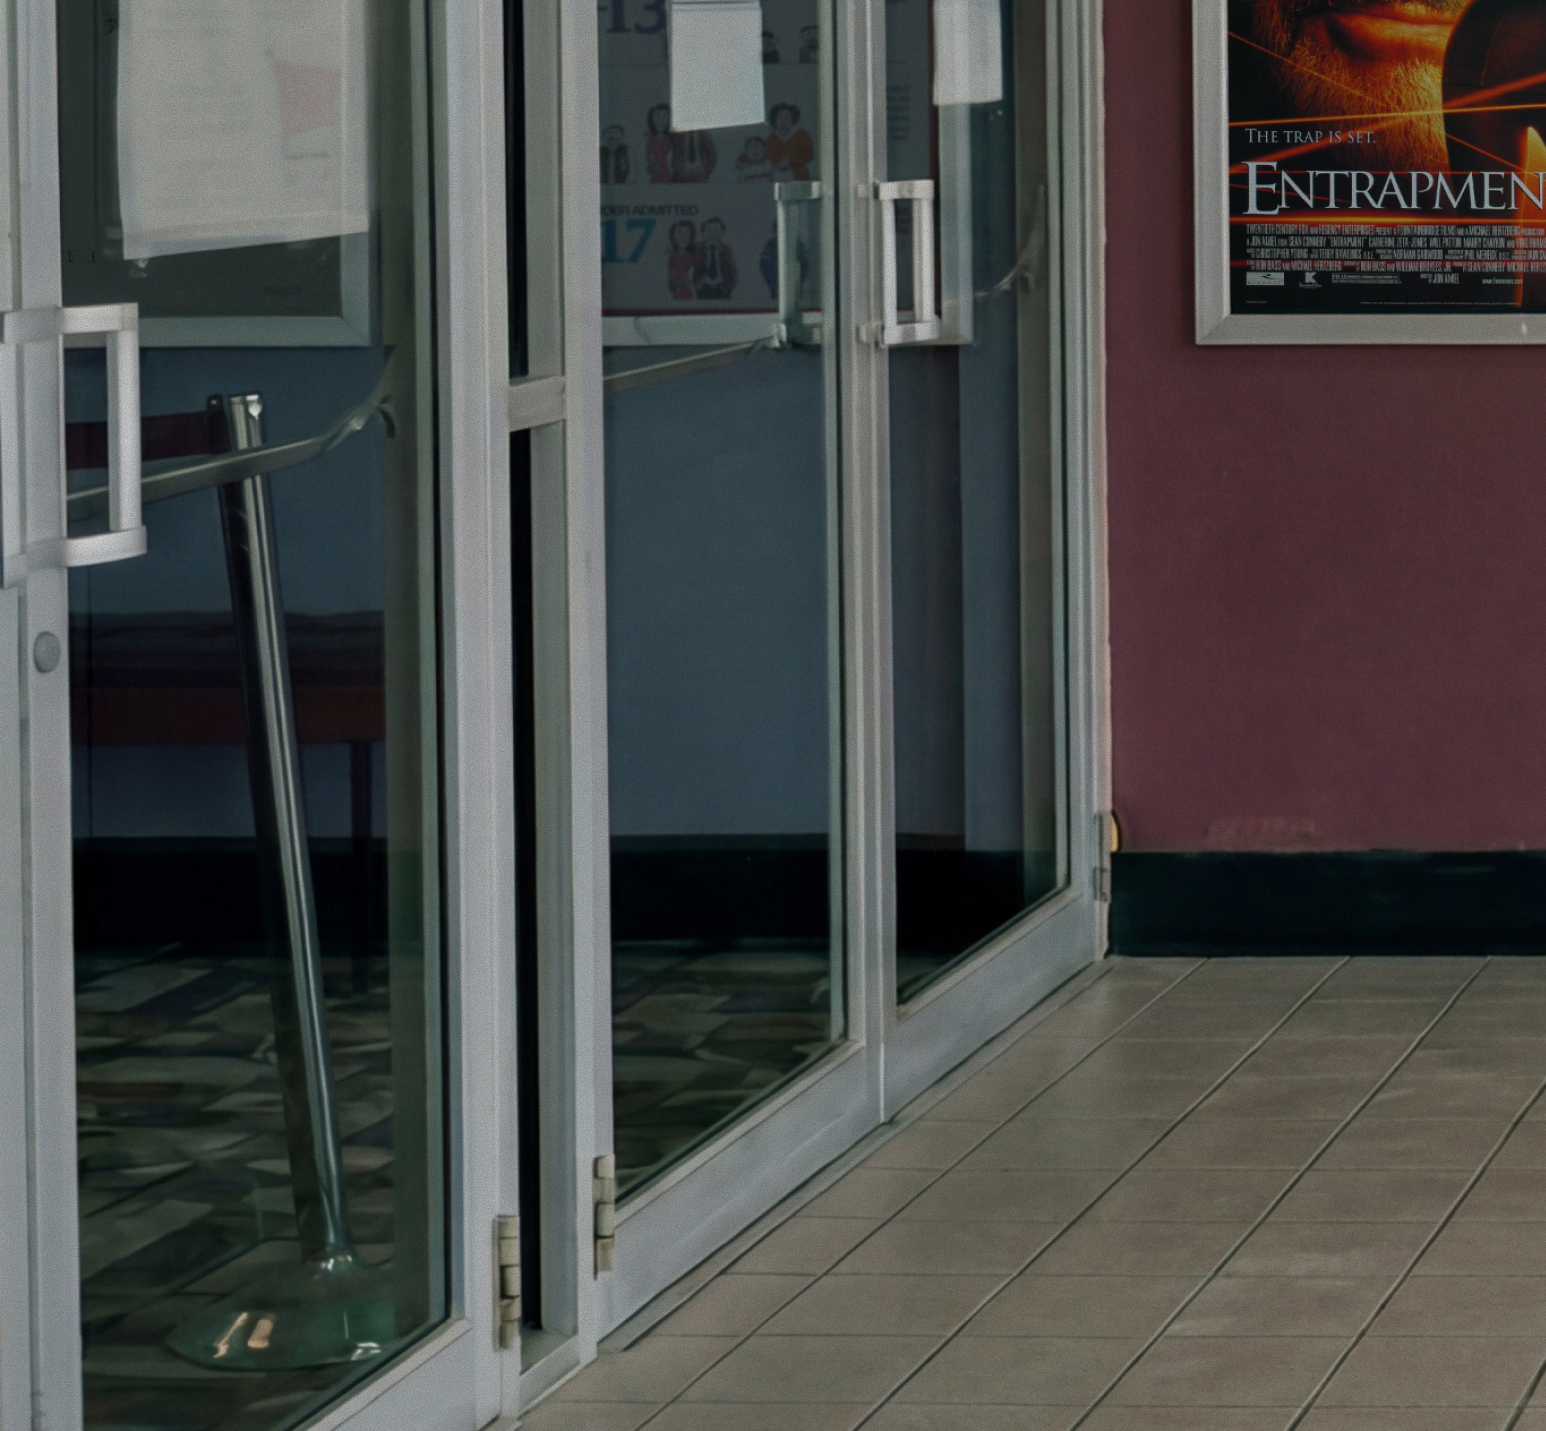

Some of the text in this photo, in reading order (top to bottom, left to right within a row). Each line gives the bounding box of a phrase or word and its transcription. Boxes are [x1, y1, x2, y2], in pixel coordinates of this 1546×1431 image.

[1245, 128, 1377, 144] THE TRAP IS SET.
[632, 205, 699, 215] ADMITTED
